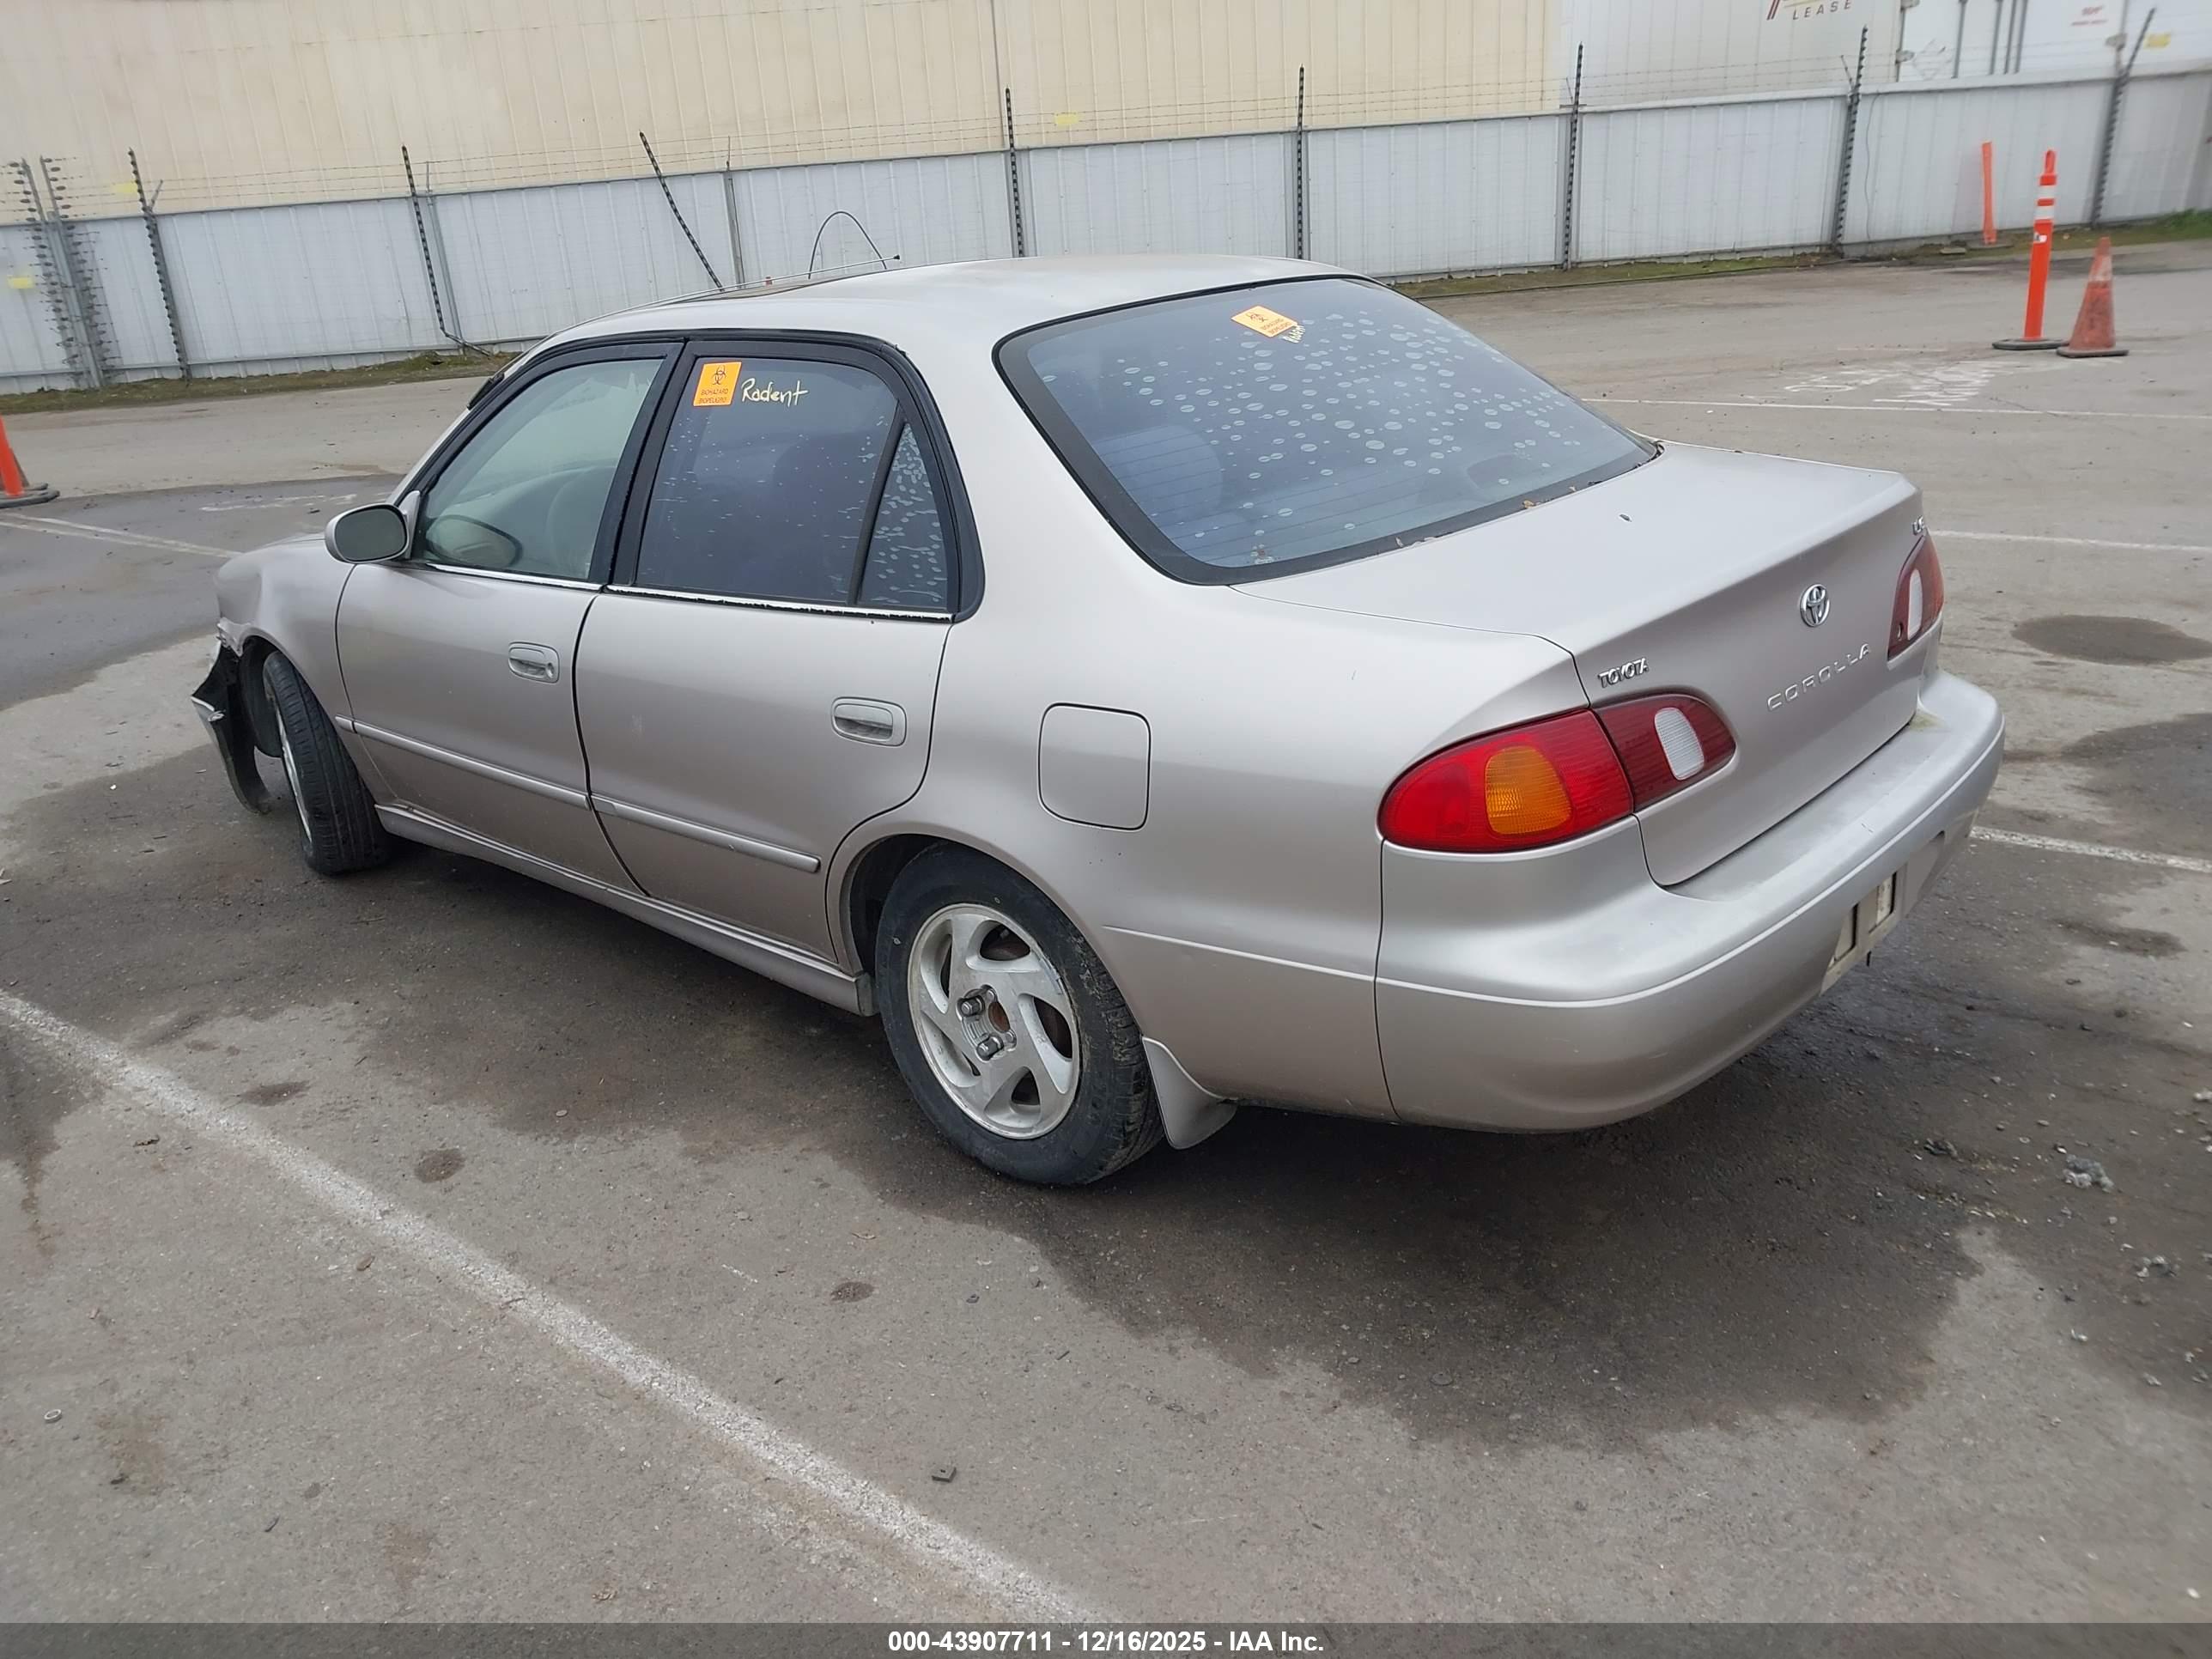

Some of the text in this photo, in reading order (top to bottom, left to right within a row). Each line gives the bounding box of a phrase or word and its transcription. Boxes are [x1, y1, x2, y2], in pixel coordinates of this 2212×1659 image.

[1792, 0, 1852, 20] LEASE
[1597, 657, 1650, 689] TOYOTA
[1766, 642, 1872, 711] COROLLA
